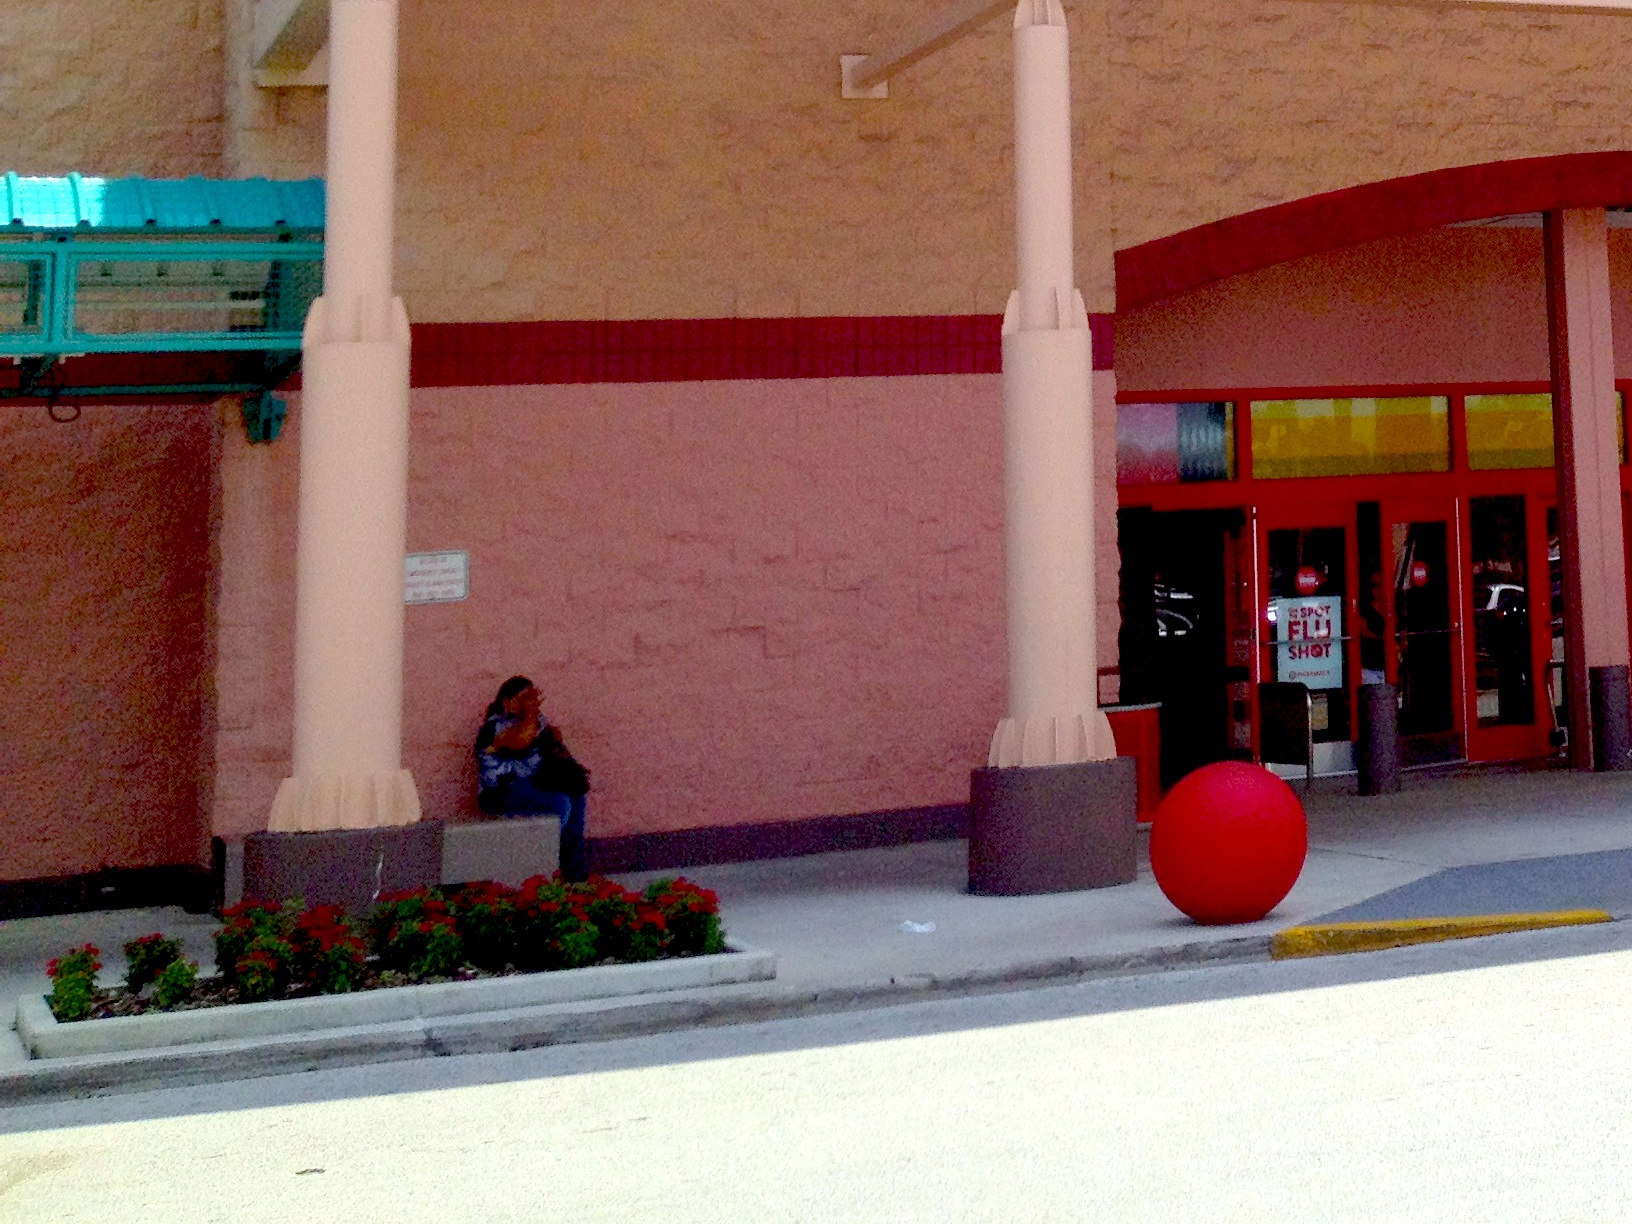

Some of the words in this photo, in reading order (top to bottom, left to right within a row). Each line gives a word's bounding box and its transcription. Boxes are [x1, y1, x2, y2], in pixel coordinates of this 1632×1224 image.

[1300, 605, 1331, 618] SPOT
[1288, 619, 1331, 641] FLU
[1288, 643, 1331, 660] SHOT
